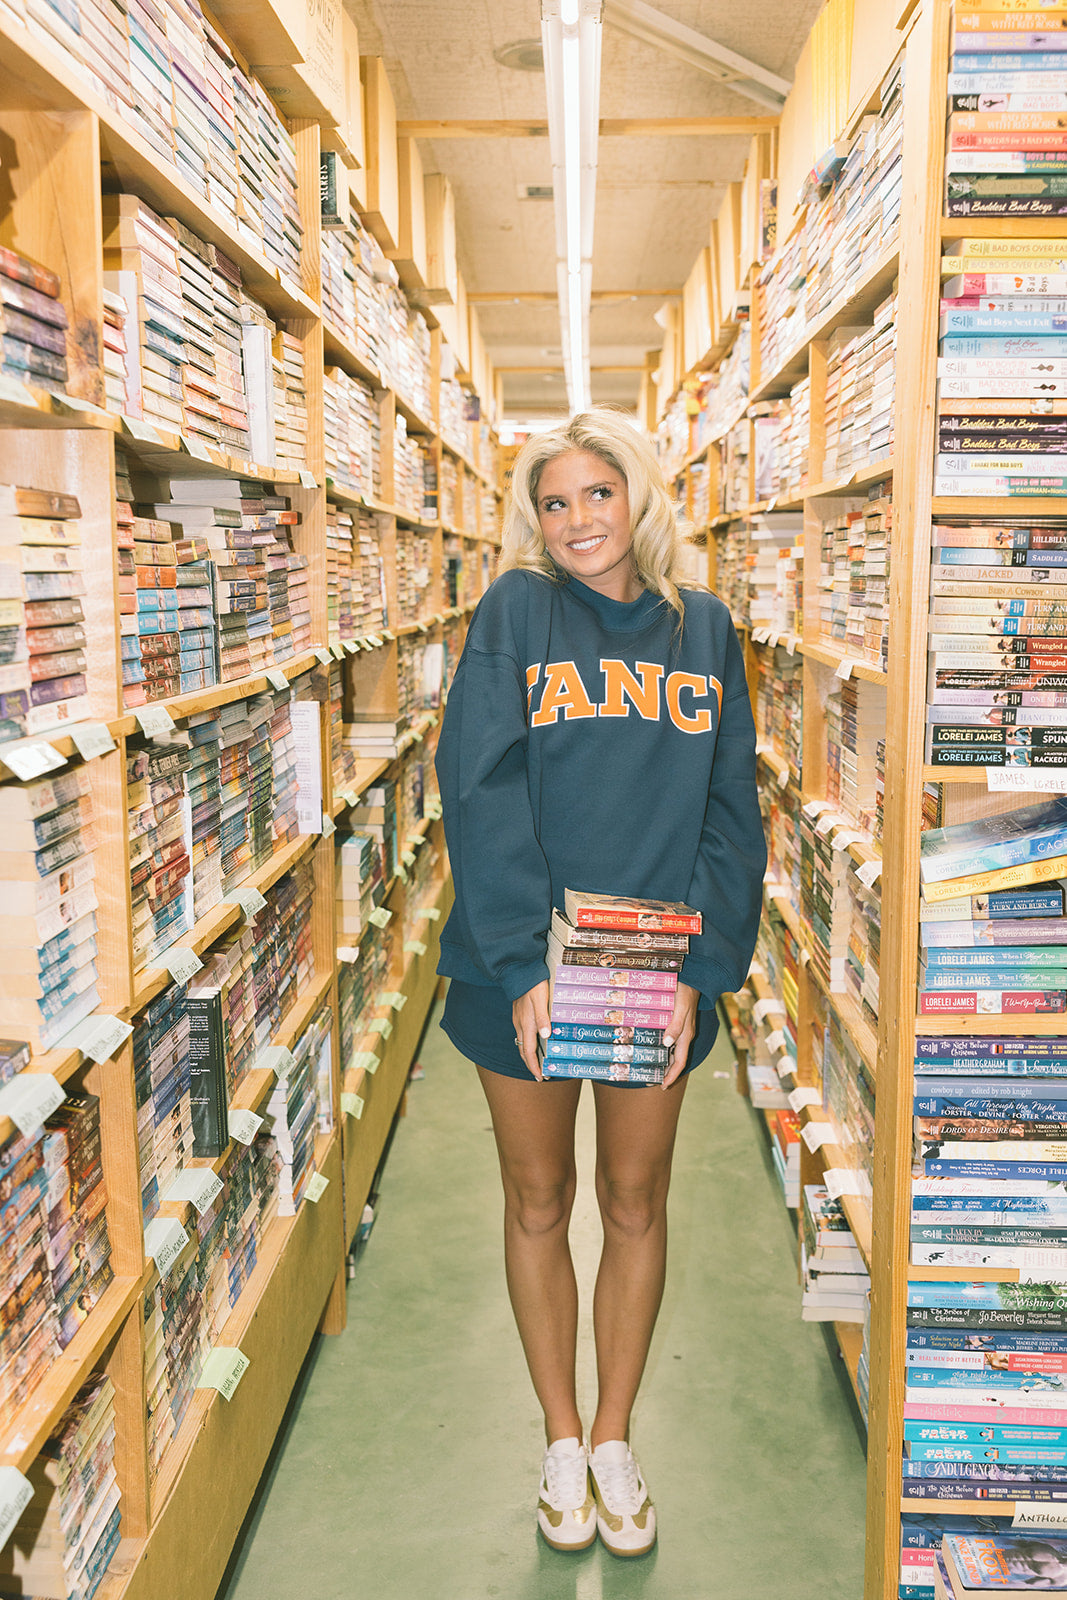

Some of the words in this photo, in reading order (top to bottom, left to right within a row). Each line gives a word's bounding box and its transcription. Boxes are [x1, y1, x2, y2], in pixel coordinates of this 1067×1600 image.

[320, 164, 329, 201] SECRETS
[971, 201, 1007, 212] Baddest
[1008, 201, 1031, 212] Bad
[1030, 201, 1053, 214] Boys
[1010, 244, 1030, 253] BOYS
[1032, 244, 1053, 253] OVER
[970, 261, 988, 270] BAD
[989, 261, 1010, 270] BOYS
[1011, 261, 1033, 269] OVER
[1034, 260, 1053, 269] EASY
[977, 318, 993, 327] Bad
[993, 318, 1013, 329] Boys
[1014, 318, 1035, 327] Next
[1036, 318, 1051, 327] Exit
[959, 418, 993, 429] Baddest
[995, 418, 1018, 429] Bad
[1017, 418, 1040, 431] Boys
[961, 438, 996, 449] Baddest
[998, 438, 1019, 449] Bad
[1018, 438, 1041, 452] Boys
[1031, 554, 1064, 562] SADDLED
[976, 570, 1014, 580] JACKED
[1033, 605, 1054, 613] TURN
[1049, 624, 1064, 632] AND
[1032, 642, 1063, 651] Wrangled
[1033, 658, 1066, 668] Wrangled
[938, 732, 974, 742] LORELEI
[975, 733, 1003, 742] JAMES
[938, 753, 974, 763] LORELEI
[974, 754, 1003, 763] JAMES
[937, 955, 967, 965] LORELEI
[967, 955, 995, 965] JAMES
[933, 976, 963, 986] LORELEI
[963, 976, 991, 986] JAMES
[925, 998, 952, 1007] LORELEI
[952, 998, 975, 1007] JAMES
[635, 1034, 656, 1045] DUKE
[952, 1041, 968, 1050] Night
[969, 1041, 989, 1049] Before
[951, 1049, 978, 1057] Christmas
[953, 1059, 980, 1069] HEATHER
[980, 1060, 1006, 1069] GRAHAM
[930, 1087, 955, 1098] cowboy
[955, 1089, 964, 1098] up
[970, 1087, 990, 1096] edited
[991, 1087, 1000, 1098] by
[1000, 1087, 1011, 1096] rob
[1012, 1087, 1033, 1098] knight
[963, 1098, 979, 1108] All
[980, 1100, 1015, 1111] Through
[1015, 1100, 1030, 1110] the
[1031, 1101, 1057, 1113] Night
[940, 1125, 968, 1134] LORDS
[969, 1126, 980, 1134] OF
[980, 1126, 1010, 1135] DESIRE
[918, 1181, 953, 1195] Wedding
[949, 1228, 974, 1236] TAKEN
[1014, 1230, 1042, 1238] JOHNSON
[945, 1235, 979, 1243] SURPRISE
[1002, 1299, 1016, 1307] The
[1015, 1297, 1054, 1311] Wishing
[945, 1310, 963, 1318] Brides
[977, 1311, 990, 1325] Jo
[989, 1311, 1026, 1325] Beverley
[933, 1355, 945, 1363] MEN
[927, 1485, 938, 1493] The
[939, 1486, 954, 1494] Night
[955, 1485, 975, 1493] Before
[974, 1538, 1010, 1585] FROST
